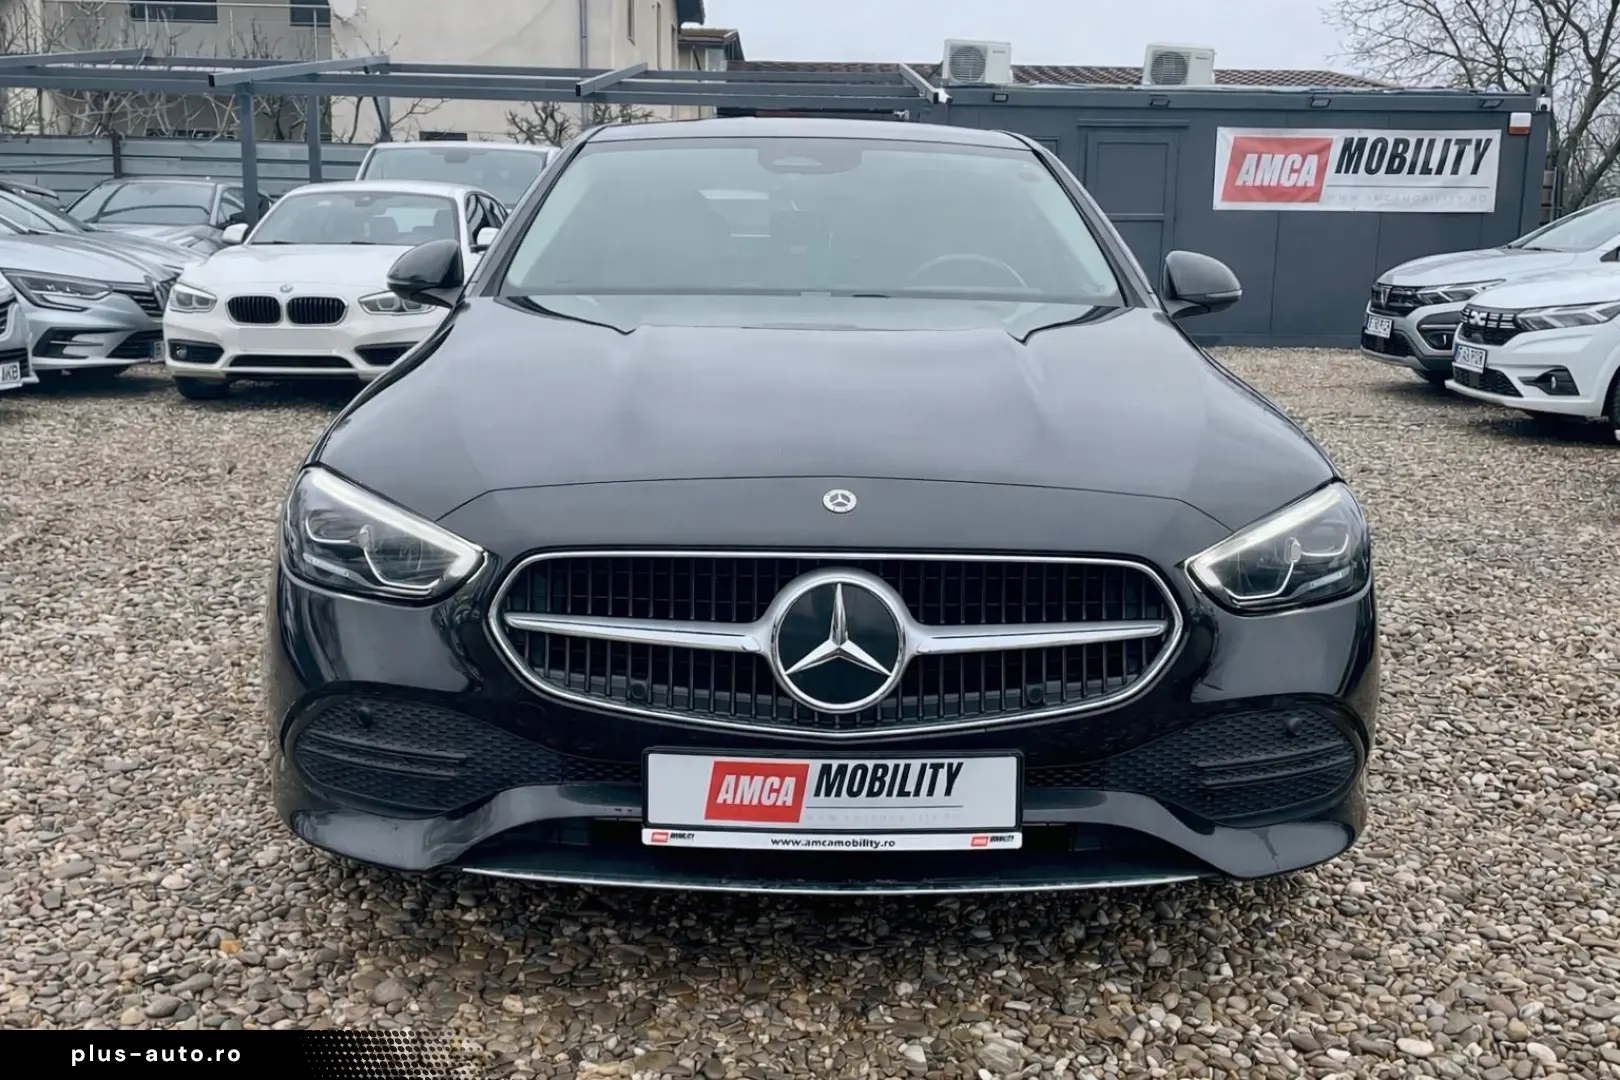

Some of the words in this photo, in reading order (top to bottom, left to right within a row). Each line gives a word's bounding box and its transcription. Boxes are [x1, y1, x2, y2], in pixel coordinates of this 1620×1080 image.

[1234, 154, 1318, 188] AMCA
[1334, 137, 1493, 176] MOBILITY
[716, 774, 797, 807] AMCA
[813, 762, 964, 799] MOBILITY
[771, 837, 896, 850] www.amcamobility.ro
